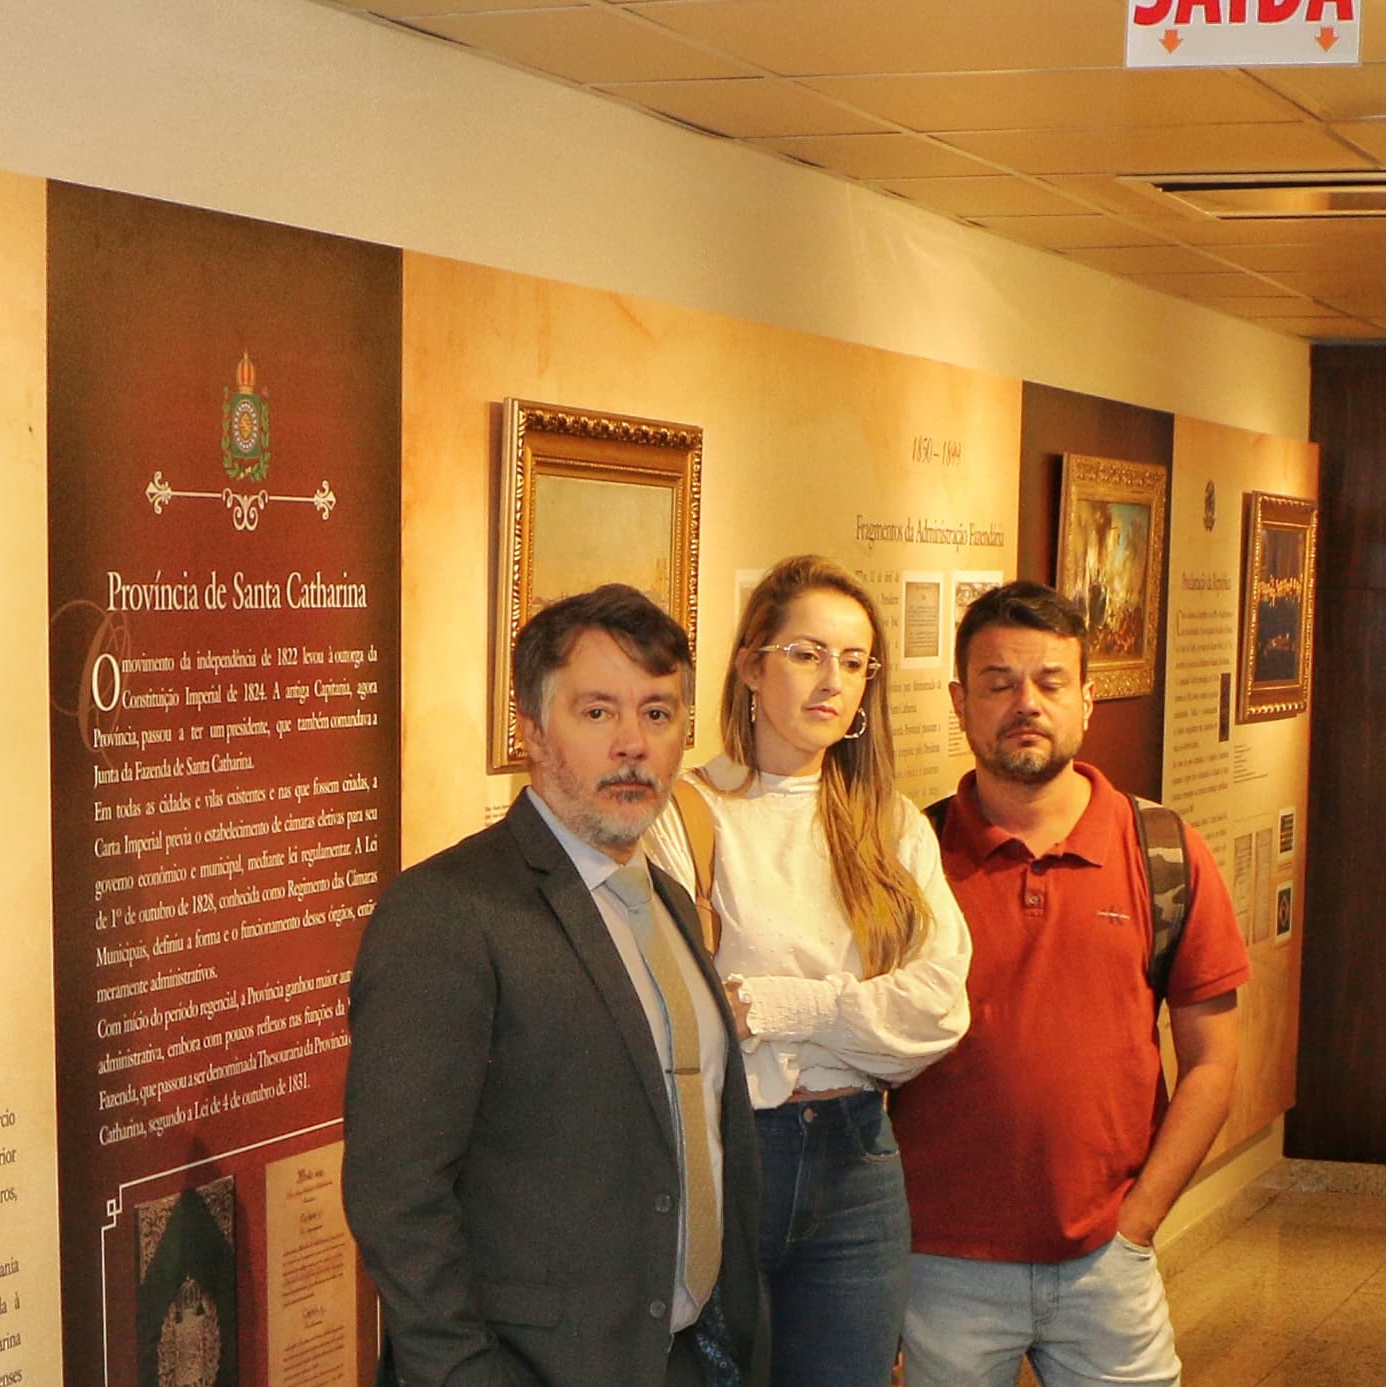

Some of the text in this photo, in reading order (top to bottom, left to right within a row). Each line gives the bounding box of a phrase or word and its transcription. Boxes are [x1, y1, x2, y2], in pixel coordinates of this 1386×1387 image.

[856, 514, 903, 549] Fragmentos
[916, 518, 968, 551] Administração
[107, 571, 367, 610] Província de Santa Catharina
[122, 658, 174, 672] movimento
[180, 653, 191, 670] da
[197, 651, 256, 674] independência
[261, 649, 272, 666] de
[278, 648, 297, 665] 1822
[302, 648, 323, 664] levou
[368, 644, 377, 661] da
[121, 680, 377, 712] Constituição Imperial de 1824. A antiga Capitania, agora
